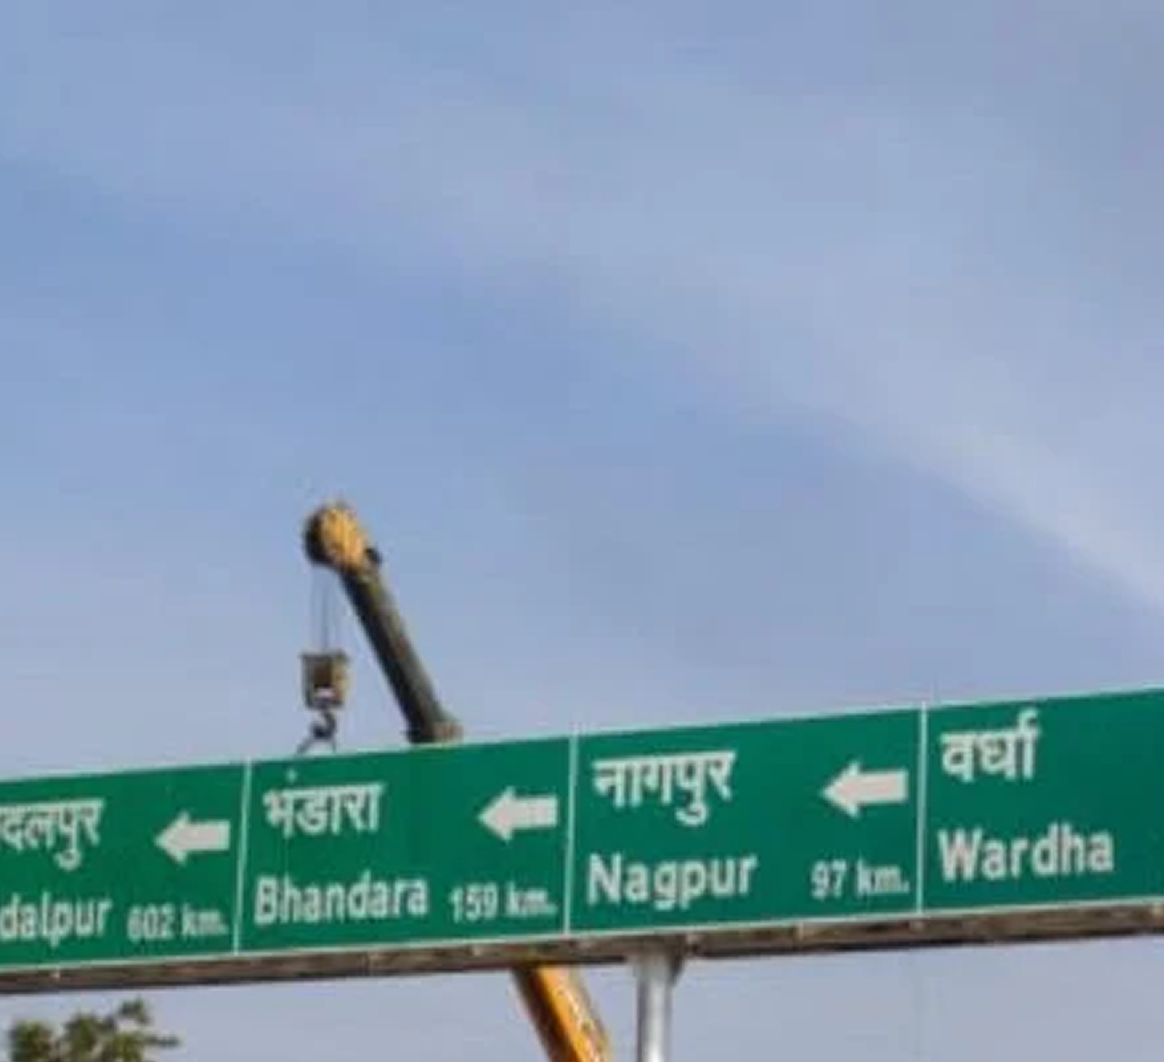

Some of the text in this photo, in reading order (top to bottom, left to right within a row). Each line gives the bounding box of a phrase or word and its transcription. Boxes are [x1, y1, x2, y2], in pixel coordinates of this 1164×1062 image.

[938, 709, 1040, 783] वर्धा
[263, 769, 384, 837] भंडारा
[592, 749, 737, 826] नागपुर
[587, 853, 910, 910] Nagpur 97 km.
[937, 822, 1115, 881] Wardha
[253, 870, 557, 925] Bhandara 159 km.
